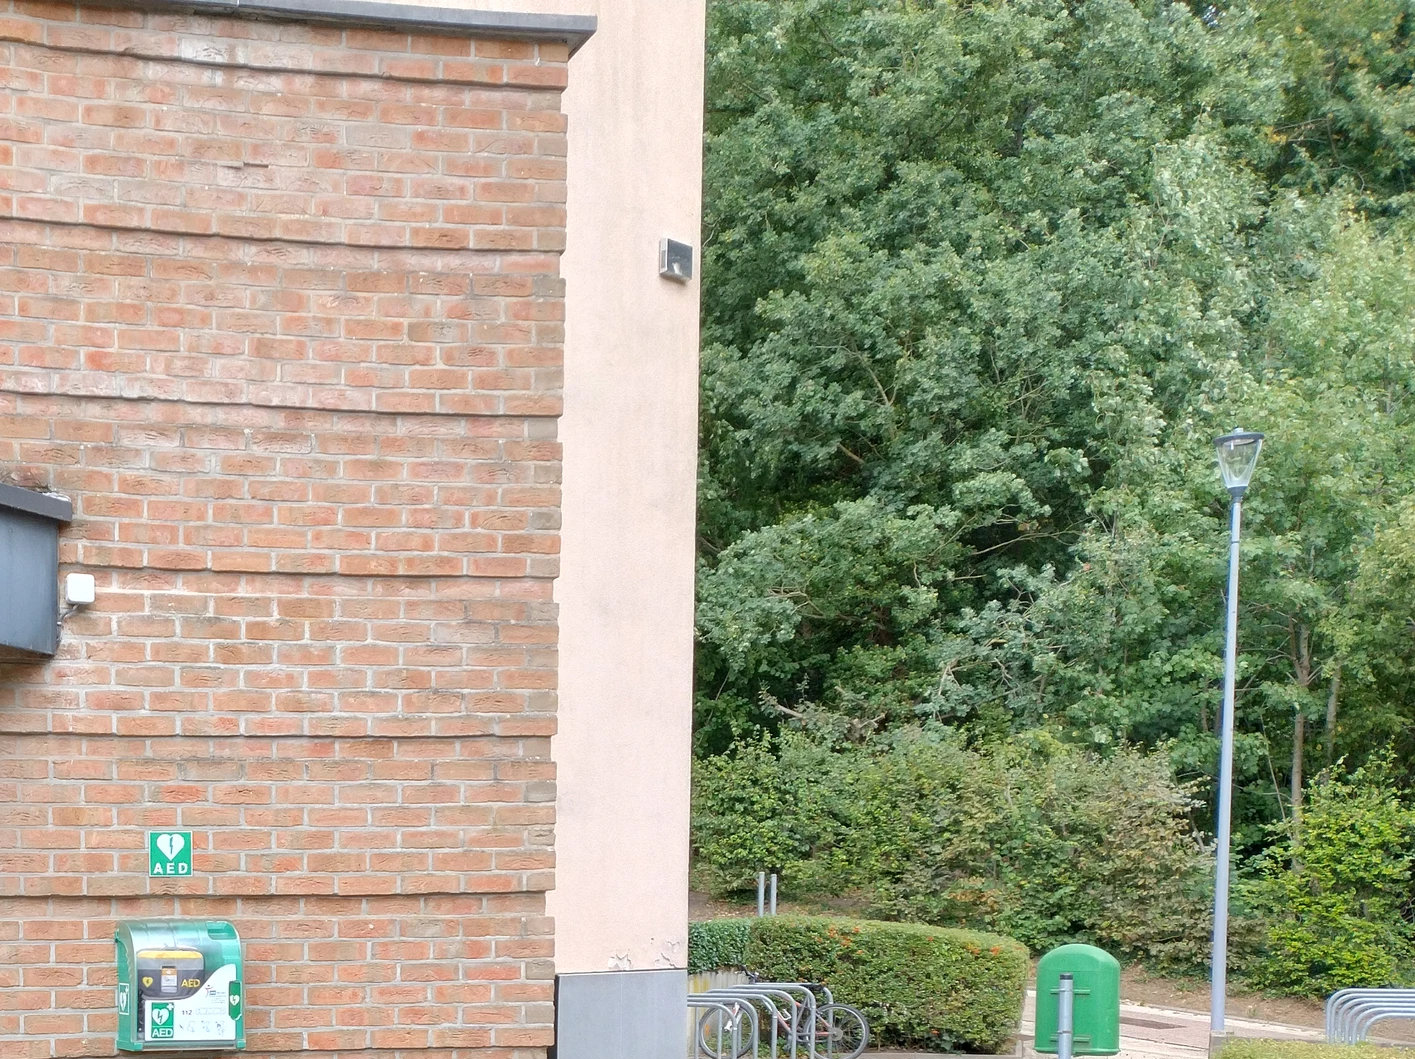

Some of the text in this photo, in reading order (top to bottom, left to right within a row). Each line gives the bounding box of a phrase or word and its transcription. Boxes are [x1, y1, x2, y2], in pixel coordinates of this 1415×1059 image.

[153, 862, 188, 874] AED
[181, 978, 200, 988] AED
[152, 1028, 173, 1038] AED
